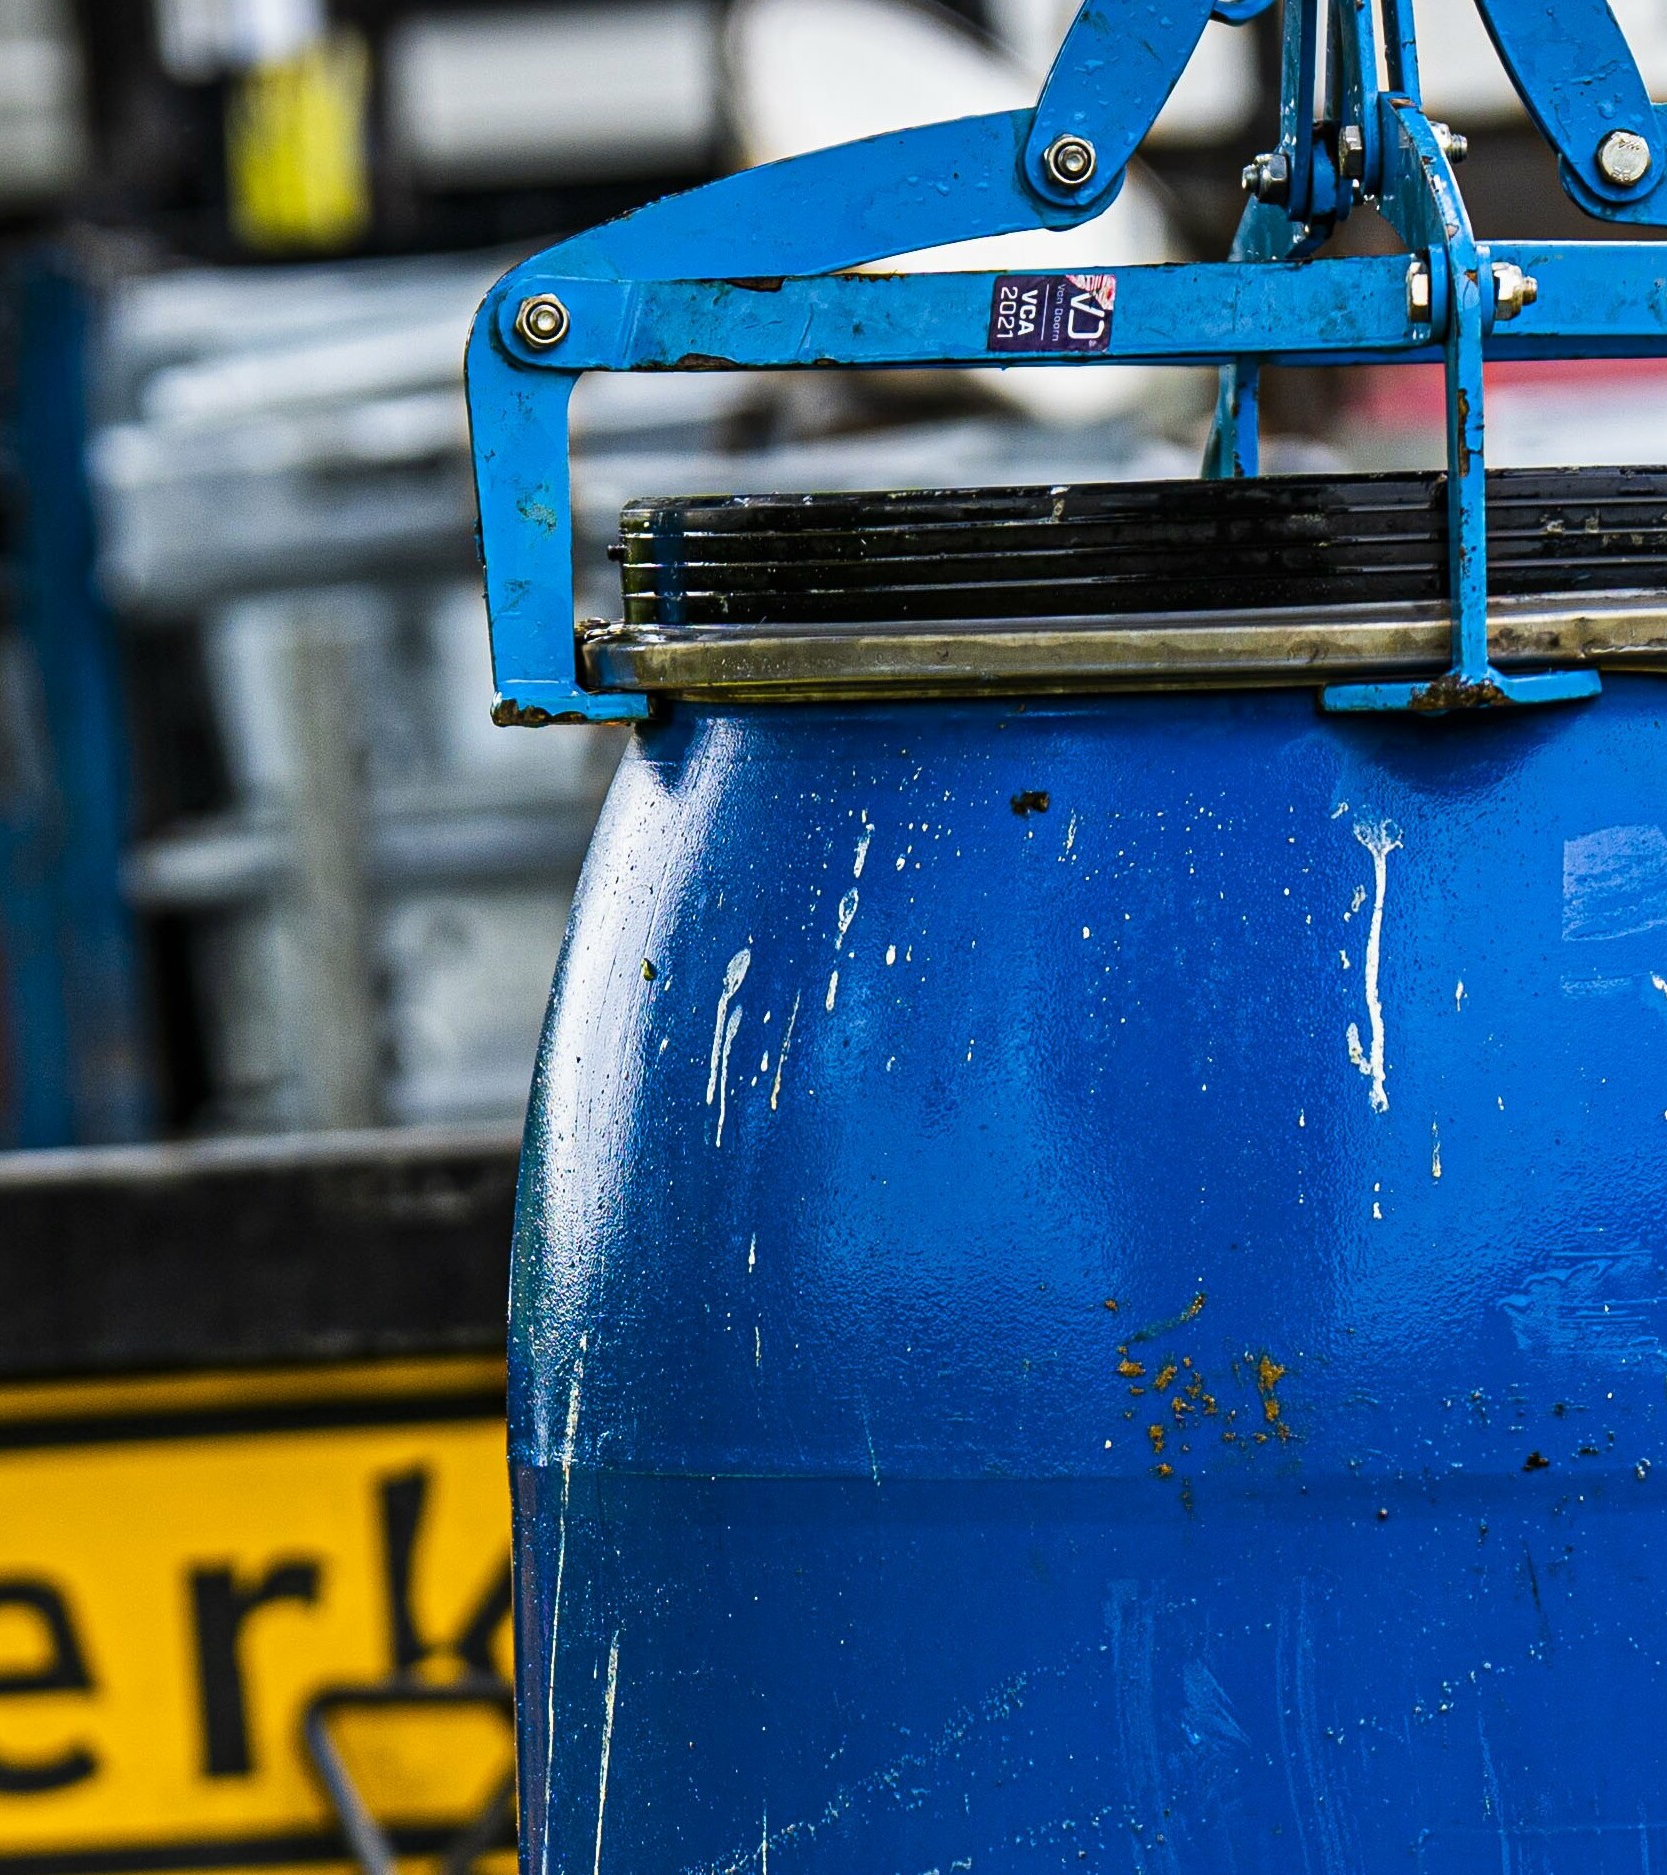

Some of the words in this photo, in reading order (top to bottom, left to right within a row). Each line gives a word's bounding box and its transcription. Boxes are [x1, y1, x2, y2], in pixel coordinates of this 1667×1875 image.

[996, 286, 1018, 338] 2021
[1017, 289, 1039, 336] VCA
[1056, 284, 1066, 304] Van
[1052, 308, 1064, 342] Doorn
